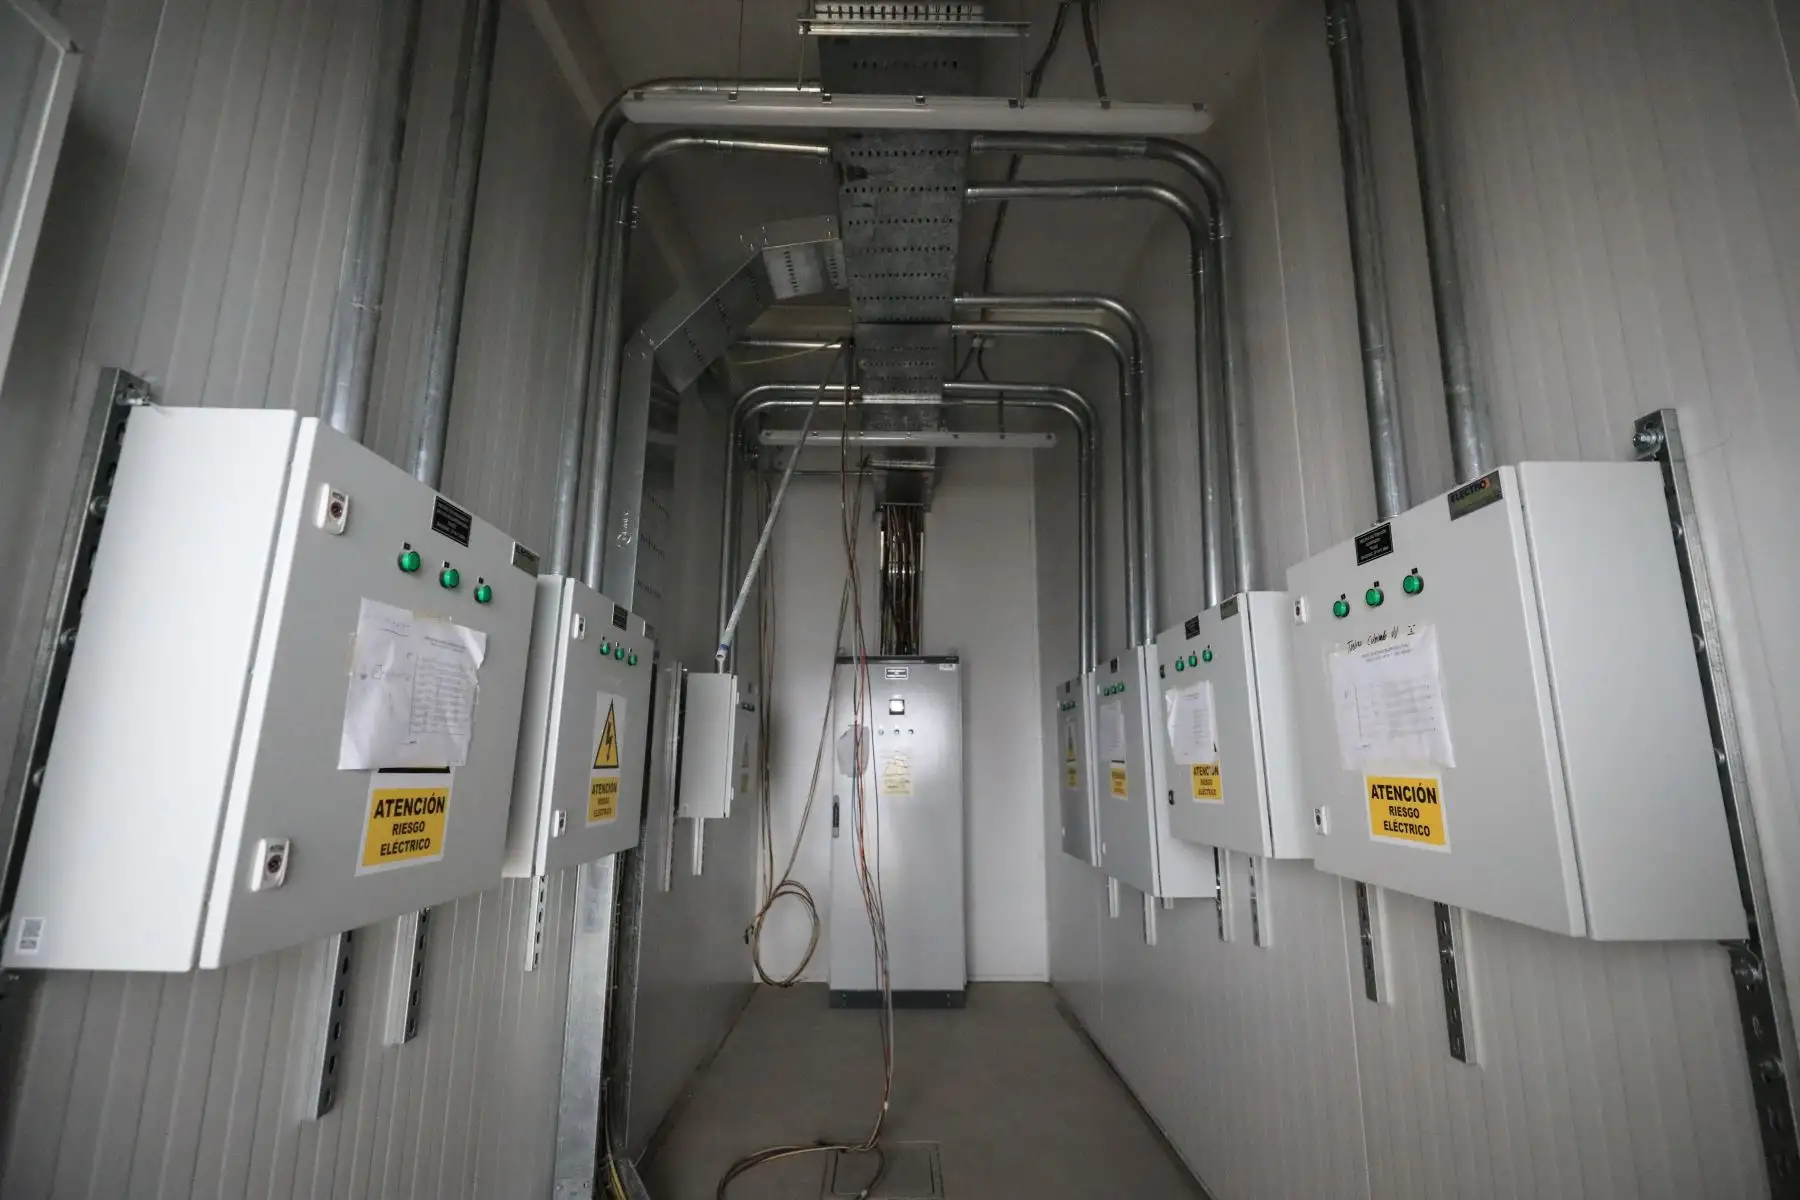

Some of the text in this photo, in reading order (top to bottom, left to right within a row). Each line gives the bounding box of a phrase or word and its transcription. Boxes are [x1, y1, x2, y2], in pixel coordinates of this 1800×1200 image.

[1193, 766, 1219, 776] ATENCN
[592, 781, 617, 795] ATENCIÓN
[1371, 783, 1438, 804] ATENCIÓN
[373, 792, 446, 819] ATENCIÓN
[1388, 805, 1420, 819] RIESGO
[391, 820, 425, 836] RIESGO
[1383, 818, 1431, 837] ELÉCTRICO
[380, 837, 431, 857] ELÉCTRICO
